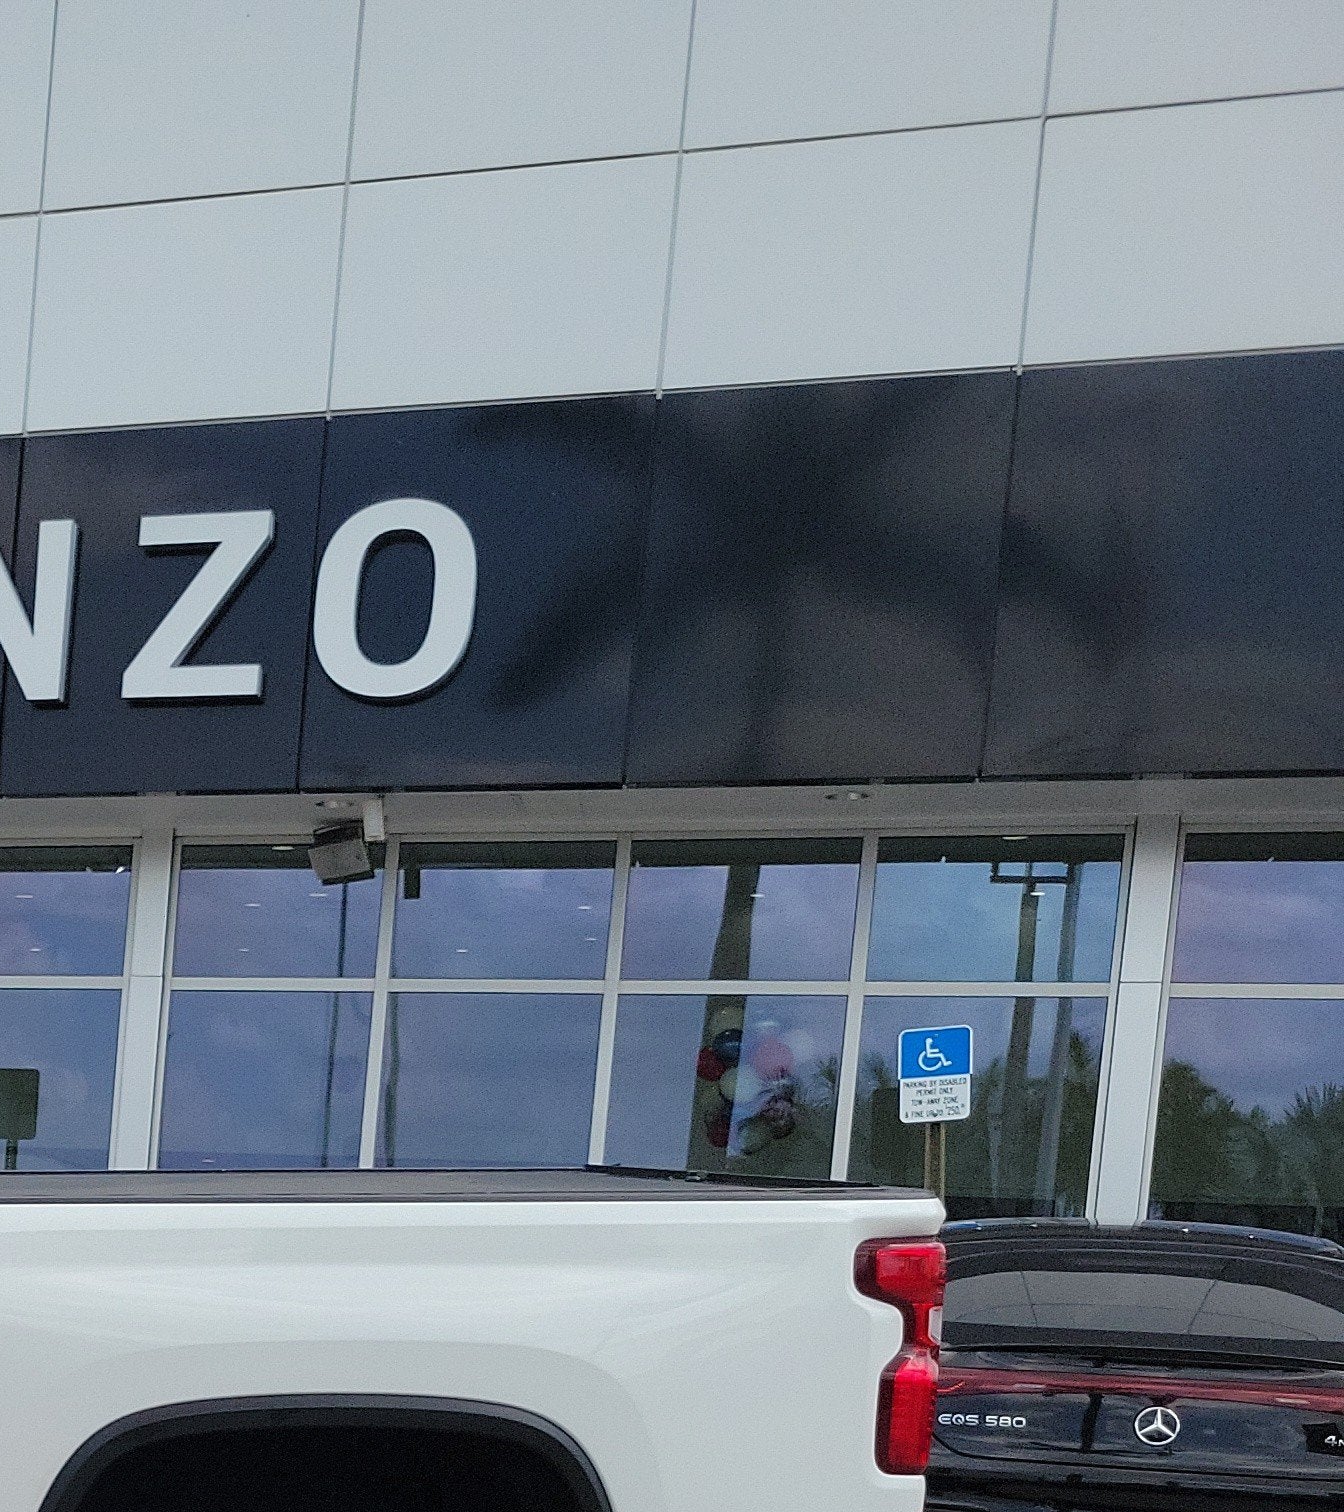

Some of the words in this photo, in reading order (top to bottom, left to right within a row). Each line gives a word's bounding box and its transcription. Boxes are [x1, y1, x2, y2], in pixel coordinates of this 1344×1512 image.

[902, 1080, 928, 1089] PARKING
[938, 1077, 967, 1086] DISABLED
[915, 1088, 937, 1096] PERMIT
[938, 1087, 953, 1095] ONLY
[942, 1096, 959, 1104] ZONE
[937, 1413, 980, 1426] EQS
[985, 1415, 1027, 1428] 580
